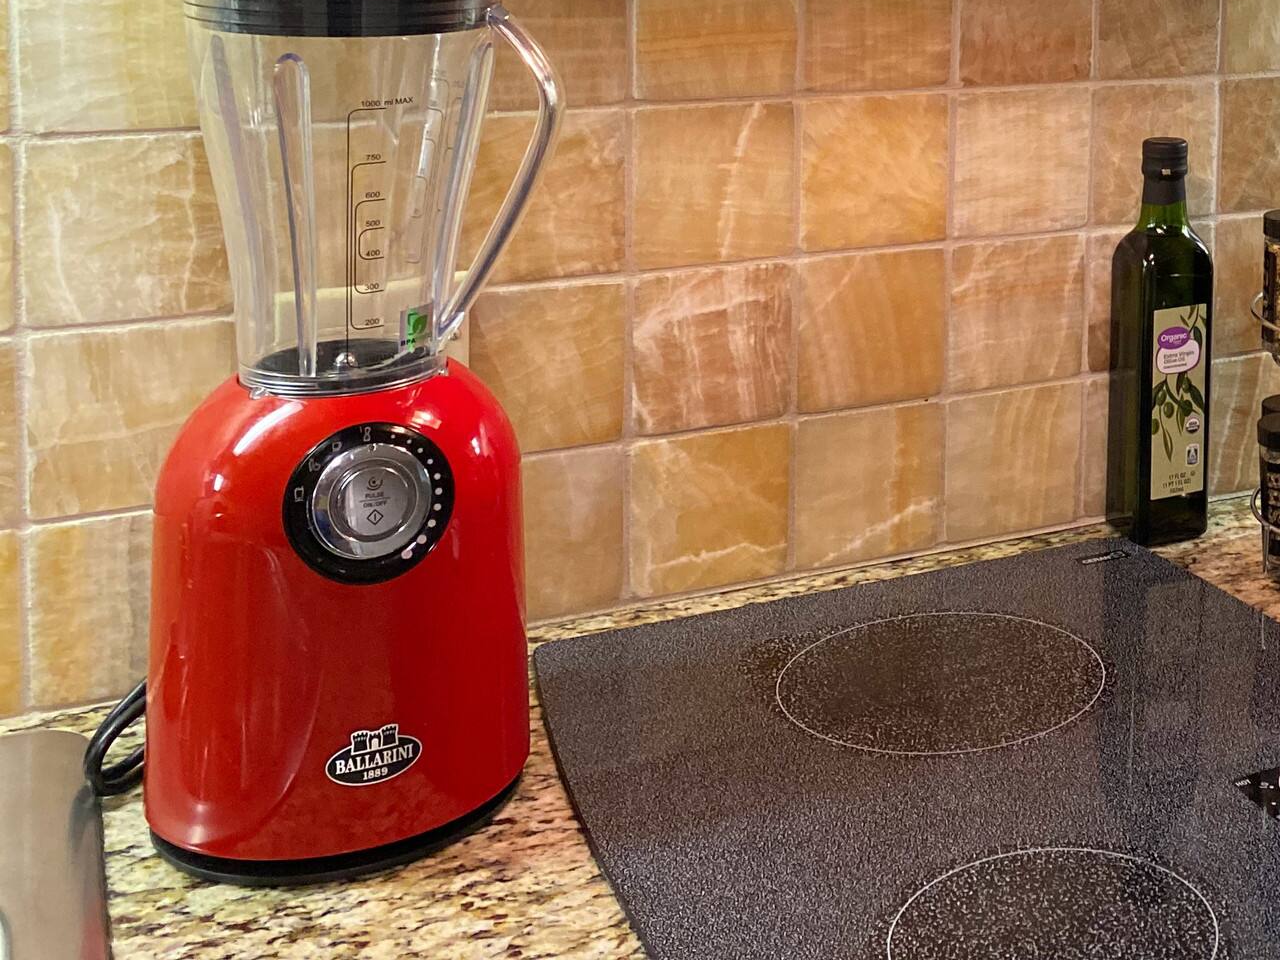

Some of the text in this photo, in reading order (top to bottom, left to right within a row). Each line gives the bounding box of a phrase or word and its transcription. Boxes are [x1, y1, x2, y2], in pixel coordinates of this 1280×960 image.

[361, 100, 381, 108] 1000
[395, 97, 414, 106] MAX
[365, 191, 381, 199] 600
[366, 219, 381, 227] 500
[366, 249, 381, 257] 400
[365, 283, 380, 291] 300
[365, 318, 380, 326] 200
[1161, 333, 1187, 343] Organic
[335, 743, 414, 775] BALLARINI
[363, 766, 388, 781] 1889
